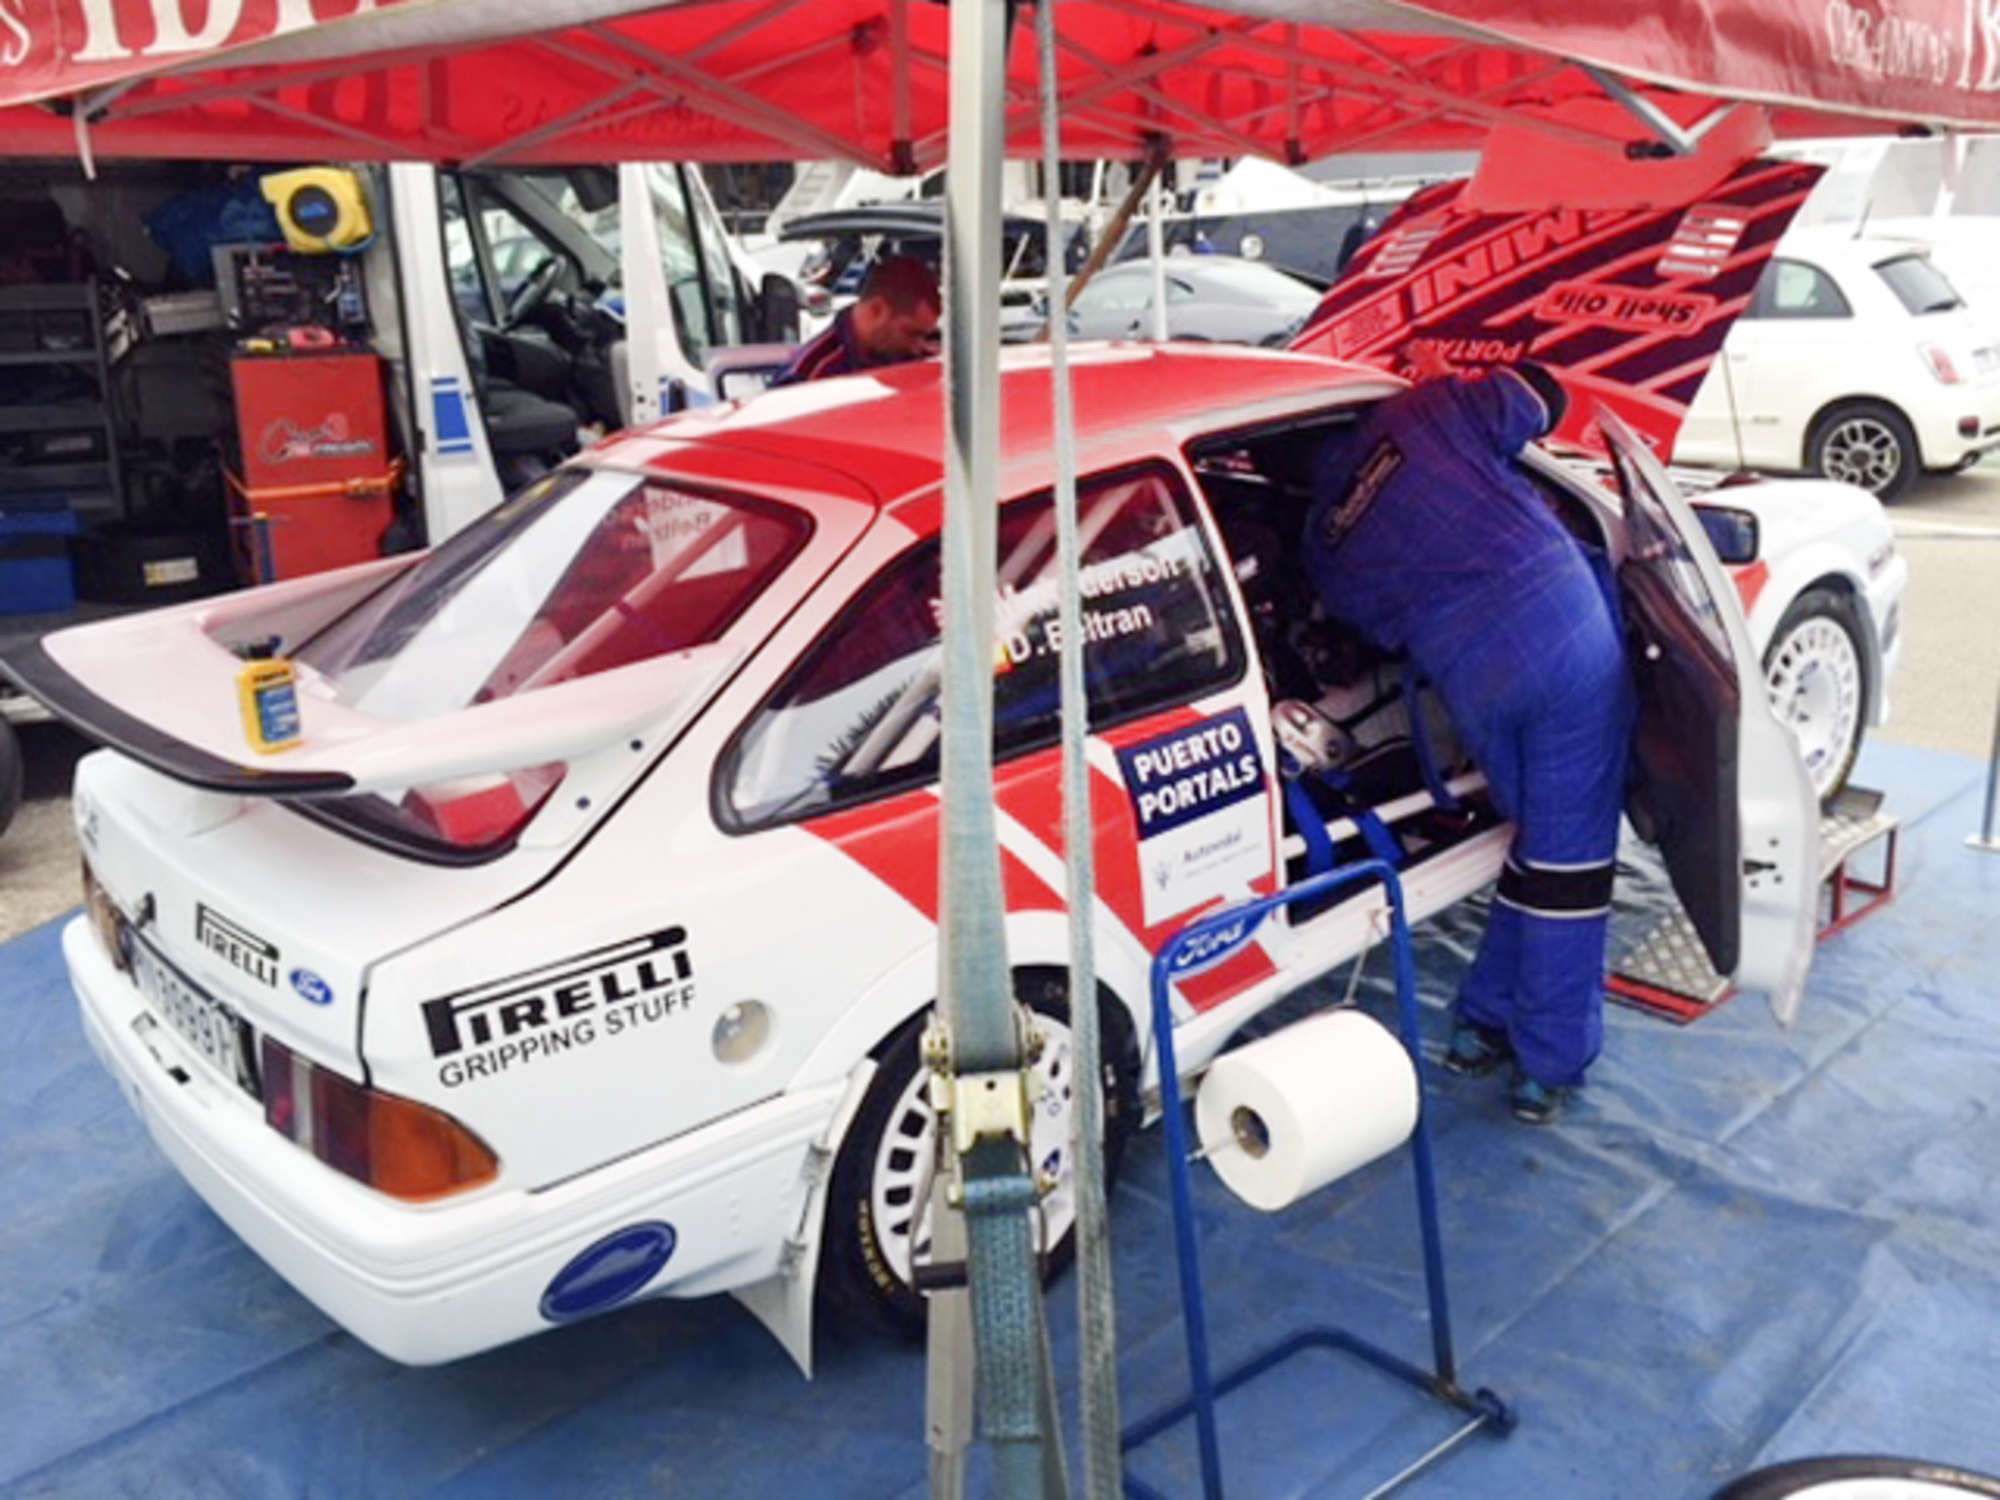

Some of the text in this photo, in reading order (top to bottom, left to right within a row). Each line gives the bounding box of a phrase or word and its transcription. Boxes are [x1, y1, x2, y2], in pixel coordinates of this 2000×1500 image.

[1613, 297, 1697, 324] Shell
[1008, 603, 1153, 664] D.Bltran
[1133, 722, 1242, 785] PUERTO
[1138, 754, 1259, 824] PORTALS
[196, 901, 280, 989] PIRELLI
[420, 924, 693, 1059] PIRELLI
[438, 984, 697, 1088] GRIPPING STUFF
